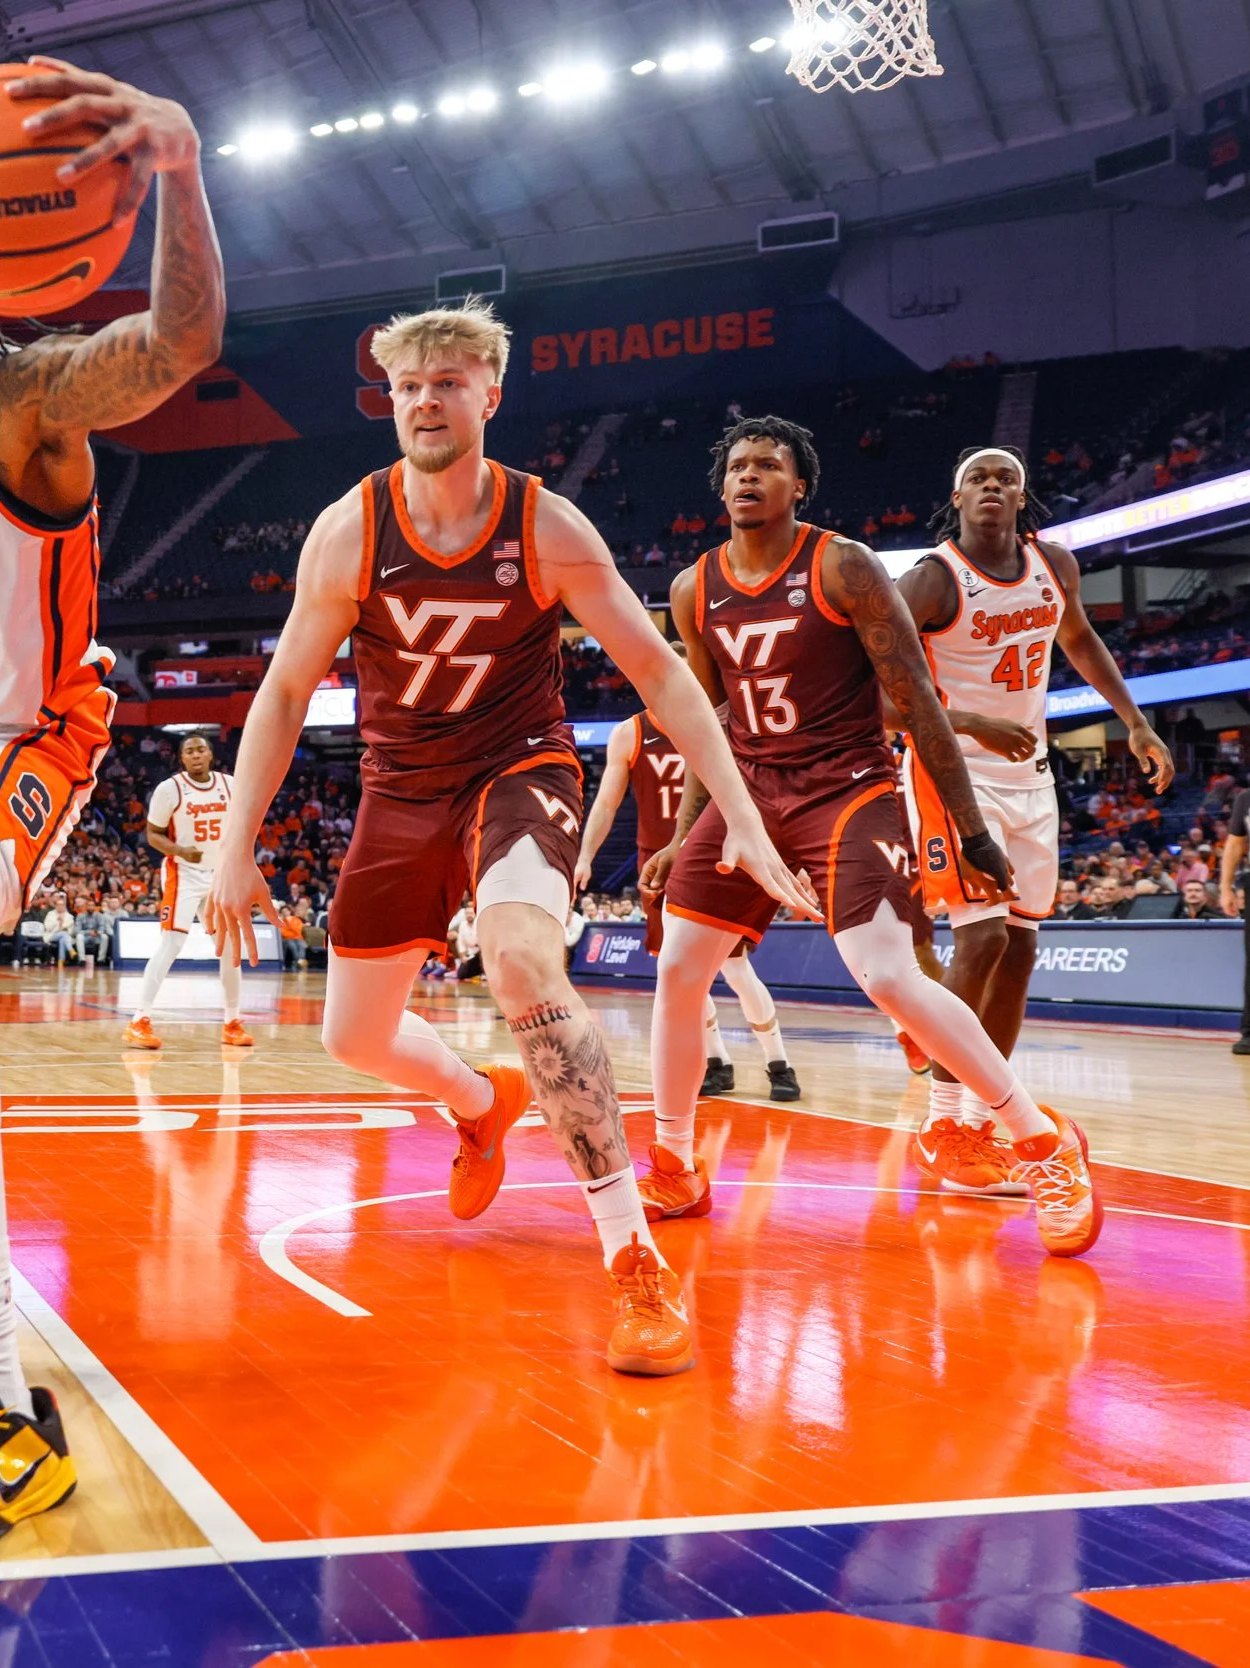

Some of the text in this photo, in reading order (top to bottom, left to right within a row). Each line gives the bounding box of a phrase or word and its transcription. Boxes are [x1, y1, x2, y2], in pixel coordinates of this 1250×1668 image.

[531, 307, 776, 374] SYRACUSE
[379, 592, 512, 656] VT
[710, 614, 804, 671] VT
[396, 649, 496, 714] 77
[991, 640, 1047, 693] 42
[736, 673, 799, 737] 13
[8, 771, 53, 841] S
[193, 819, 223, 844] 55
[926, 835, 949, 874] S
[609, 935, 642, 951] Hidden
[1034, 947, 1130, 973] AREERS
